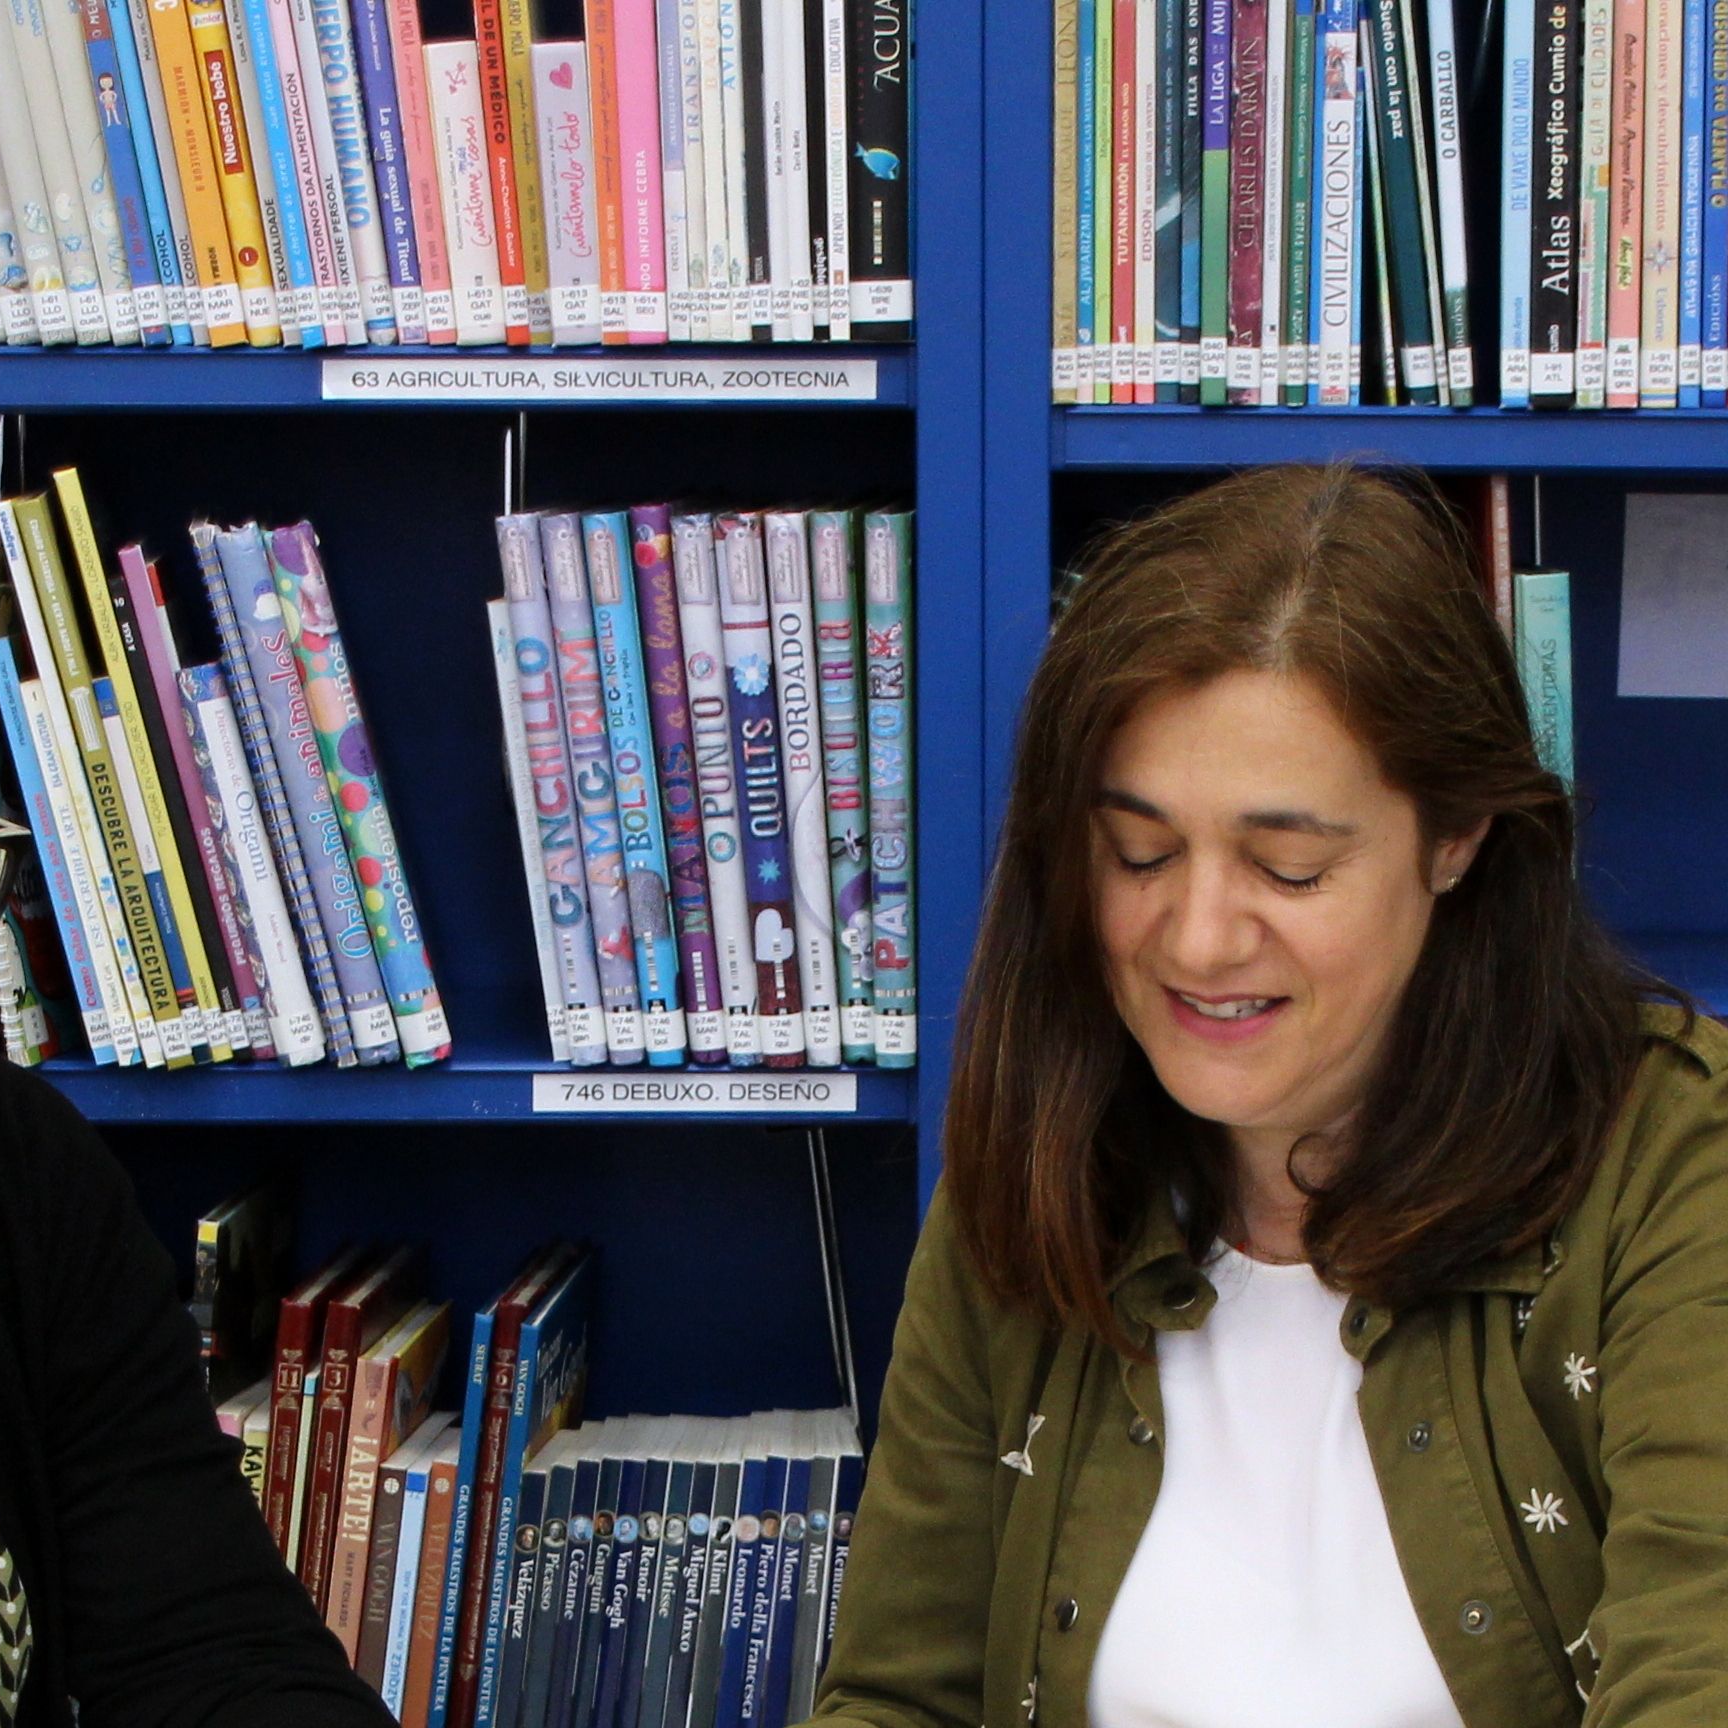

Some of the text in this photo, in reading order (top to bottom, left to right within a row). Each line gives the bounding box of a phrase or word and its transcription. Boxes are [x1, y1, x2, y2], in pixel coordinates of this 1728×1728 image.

[485, 49, 498, 79] UN
[1186, 37, 1199, 117] FILLA DAS
[1209, 60, 1226, 126] LA LIGA
[1437, 49, 1457, 159] O CARBALLO
[206, 60, 240, 166] Nuestro bebe
[377, 107, 392, 128] La
[487, 81, 506, 145] MÉDICO
[1237, 36, 1263, 249] CHARLES DARWIN
[1541, 5, 1571, 296] Atlas Xeográfico Cumio de
[329, 94, 372, 231] HUMANO
[384, 164, 403, 213] sexual
[636, 150, 649, 194] CEBRA
[390, 215, 405, 234] de
[1117, 163, 1130, 266] TUTANKAMÓN
[1323, 117, 1352, 328] CIVILIZACIONES
[394, 235, 415, 283] Titeuf
[351, 371, 380, 389] 63
[386, 370, 546, 391] AGRICULTURA,
[722, 369, 850, 388] ZOOTECNIA
[775, 611, 813, 776] BORDADO
[514, 636, 584, 929] GANCHILLO
[615, 733, 654, 857] BOLSOS
[693, 696, 736, 821] PUNTO
[740, 716, 781, 840] QUILTS
[90, 762, 171, 1013] DESCUBRE LA ARQUITECTURA
[561, 1078, 832, 1102] 746 DEBUXO. DESEÑO
[342, 1434, 378, 1544] ¡ARTE!
[511, 1558, 535, 1640] Velázquez
[541, 1552, 562, 1612] Picasso
[563, 1548, 586, 1621] Cézanne
[587, 1544, 612, 1615] Gauguin
[605, 1549, 634, 1630] Van Gogh
[636, 1545, 656, 1603] Renoir
[658, 1554, 681, 1619] Matisse
[679, 1544, 706, 1653] Miguel Anxo
[708, 1548, 728, 1596] Klimt
[731, 1548, 754, 1629] Leonardo
[779, 1546, 800, 1601] Monet
[804, 1542, 825, 1596] Manet
[741, 1543, 776, 1720] Piero della Francesca
